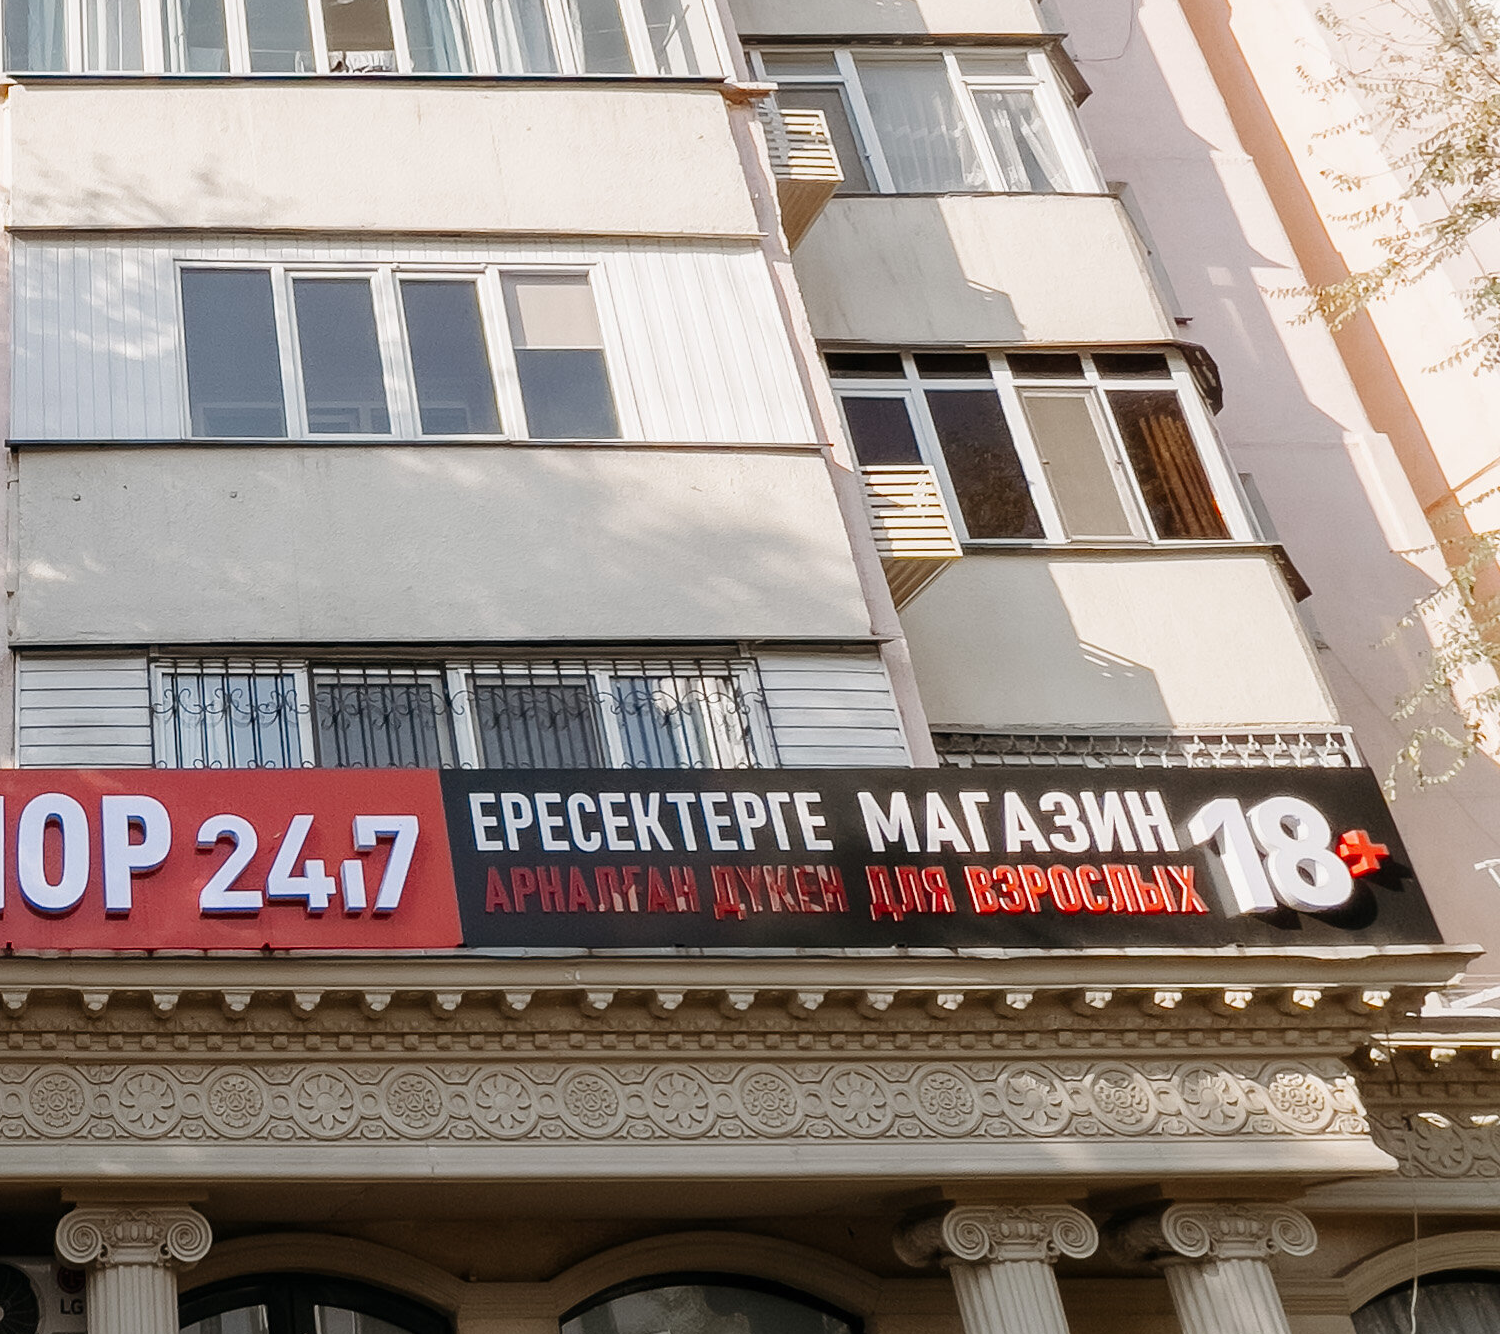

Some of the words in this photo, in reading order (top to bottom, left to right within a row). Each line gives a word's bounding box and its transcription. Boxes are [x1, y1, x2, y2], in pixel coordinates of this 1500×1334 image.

[468, 791, 834, 853] ЕРЕСЕКТЕРГЕ
[857, 790, 1180, 853] МАГАЗИН
[865, 865, 957, 921] ДЛЯ
[963, 865, 1211, 915] ВЗРОСЛЫХ
[60, 1298, 84, 1315] LG
